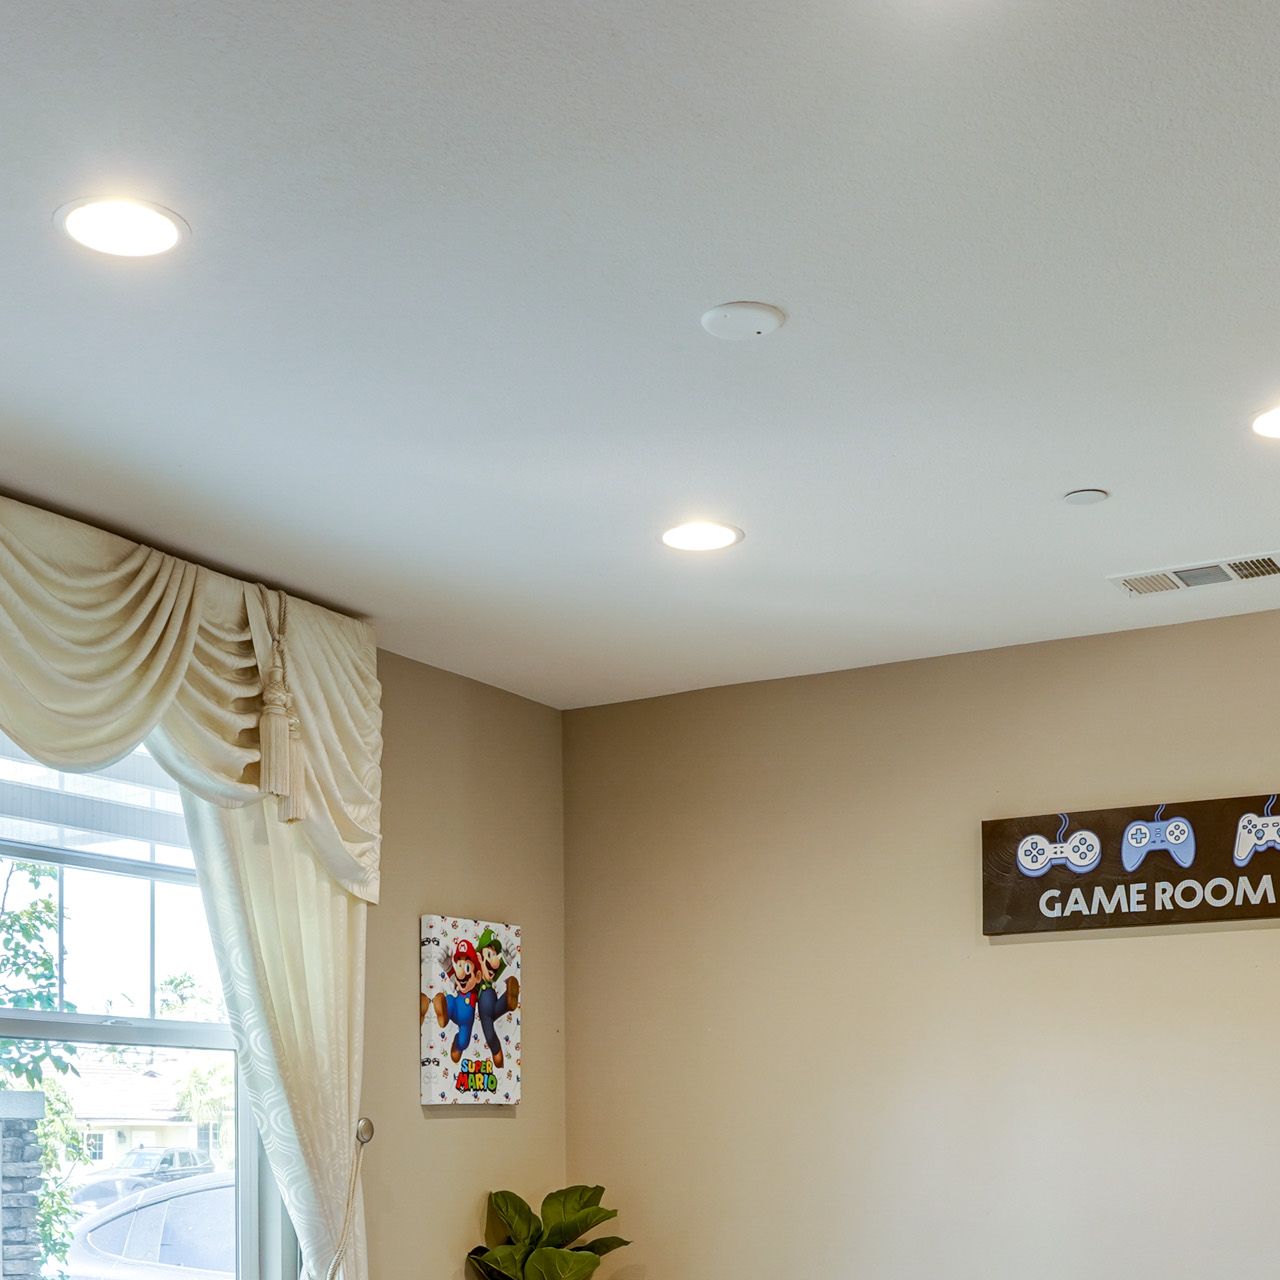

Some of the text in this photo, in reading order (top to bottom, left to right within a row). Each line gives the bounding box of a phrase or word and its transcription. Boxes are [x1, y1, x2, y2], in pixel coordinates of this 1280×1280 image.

[1038, 874, 1276, 918] GAME ROOM
[461, 1058, 493, 1074] SUPER
[455, 1072, 498, 1093] MARIO
